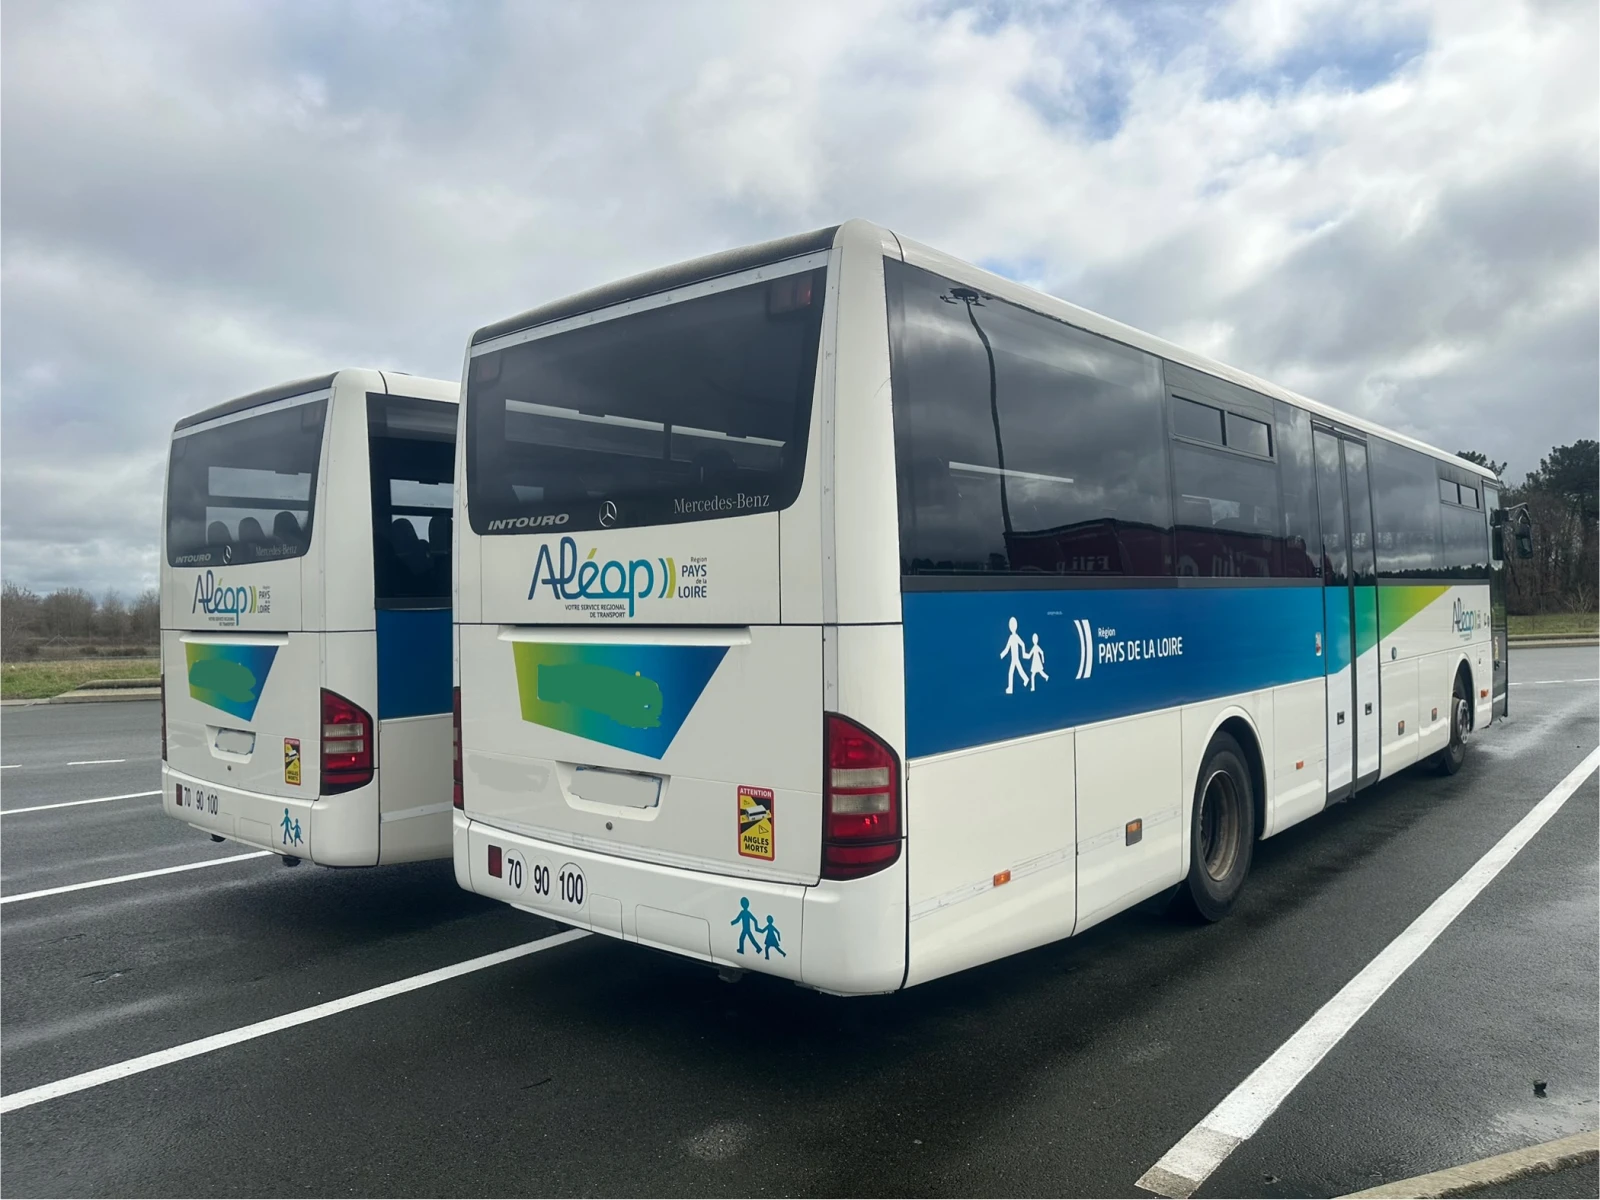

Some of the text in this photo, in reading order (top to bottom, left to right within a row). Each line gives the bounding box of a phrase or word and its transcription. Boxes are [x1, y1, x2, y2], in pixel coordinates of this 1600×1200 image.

[674, 493, 770, 514] Mercedes-Benz
[487, 512, 570, 531] INTOURO
[175, 553, 211, 563] INTOURO
[527, 536, 655, 618] Aléop
[681, 564, 708, 578] PAYS
[678, 585, 708, 599] LOIRE
[1098, 627, 1116, 639] Région
[1098, 636, 1183, 664] PAYS DE LA LOIRE
[739, 787, 772, 798] ATTENTION
[184, 786, 219, 815] 70 90 100
[743, 835, 770, 846] ANGLES
[744, 843, 769, 854] MORTS
[507, 858, 584, 905] 70 90 100
